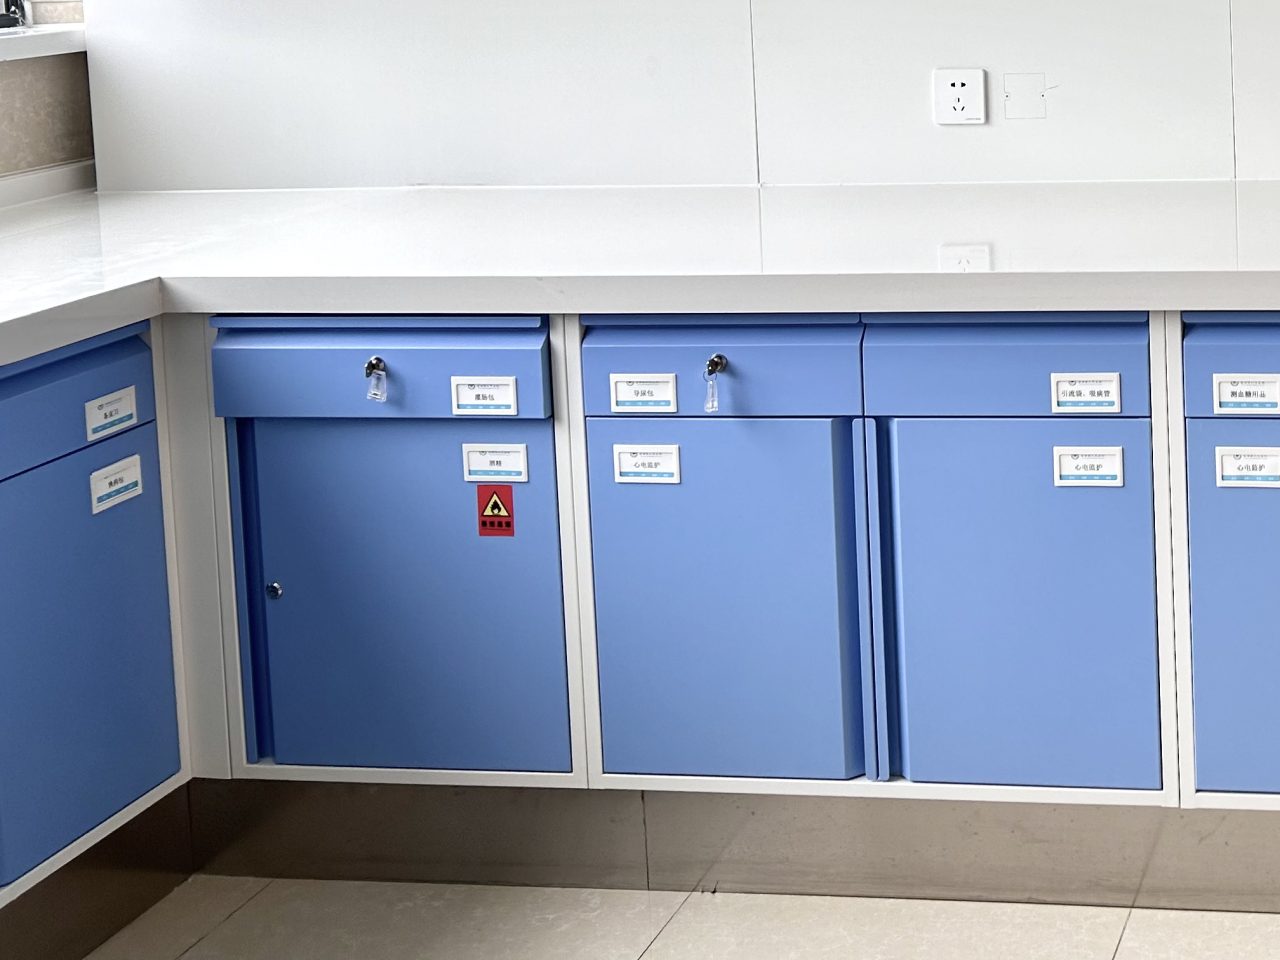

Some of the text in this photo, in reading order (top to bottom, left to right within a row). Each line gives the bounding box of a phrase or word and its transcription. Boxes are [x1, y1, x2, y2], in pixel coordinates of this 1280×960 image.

[1230, 390, 1266, 398] 测血糖用品
[633, 461, 661, 469] 心电监护
[1074, 463, 1103, 471] 心电监护
[1237, 464, 1266, 472] 心电监护
